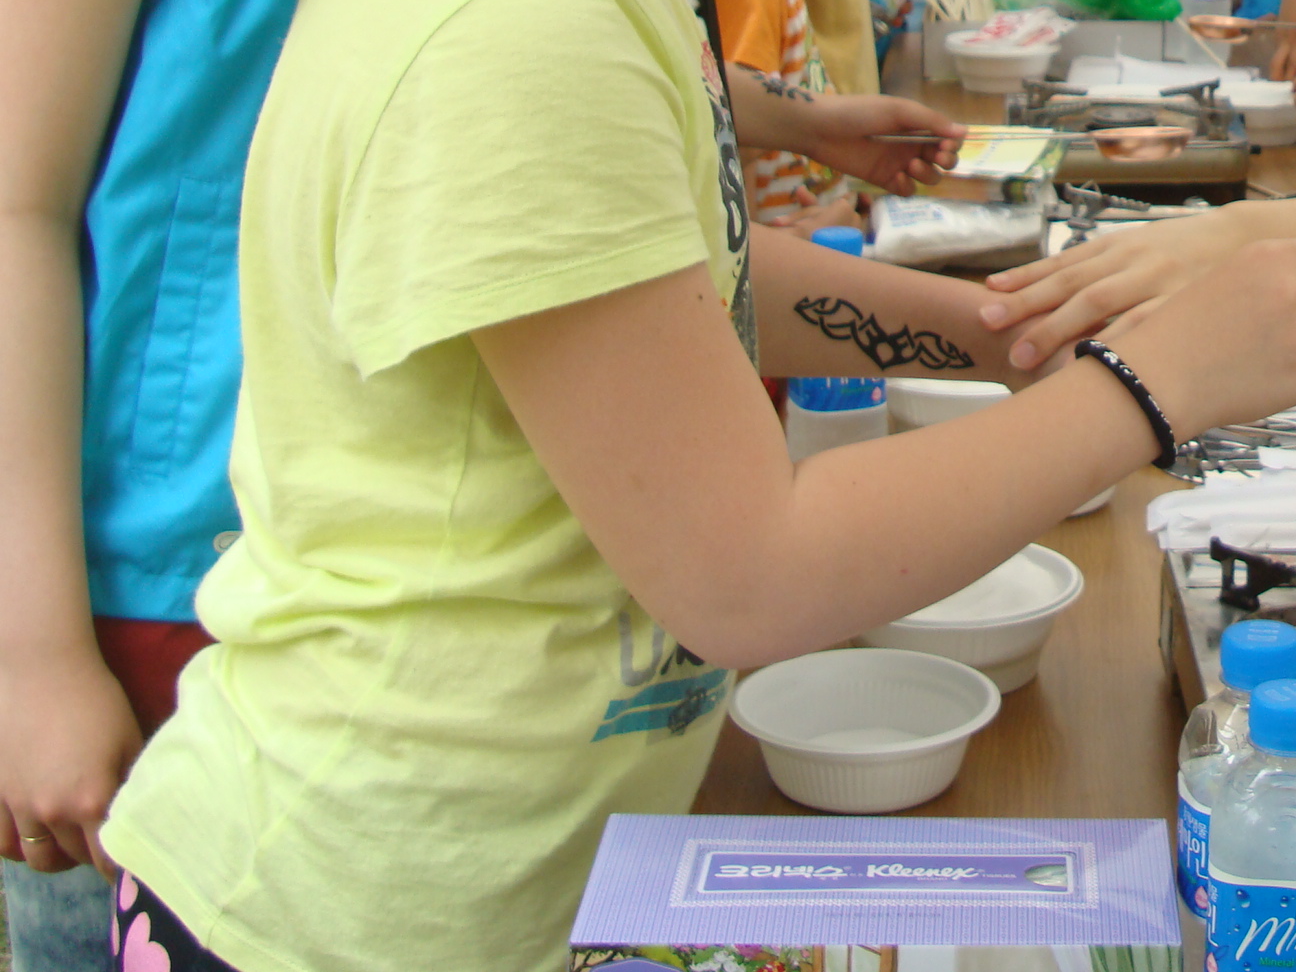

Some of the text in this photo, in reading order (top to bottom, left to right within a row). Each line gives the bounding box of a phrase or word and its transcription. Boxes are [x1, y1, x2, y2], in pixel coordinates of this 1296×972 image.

[714, 864, 848, 878] 크리넥스
[866, 863, 979, 880] Kleenex
[1258, 957, 1294, 967] Mineral
